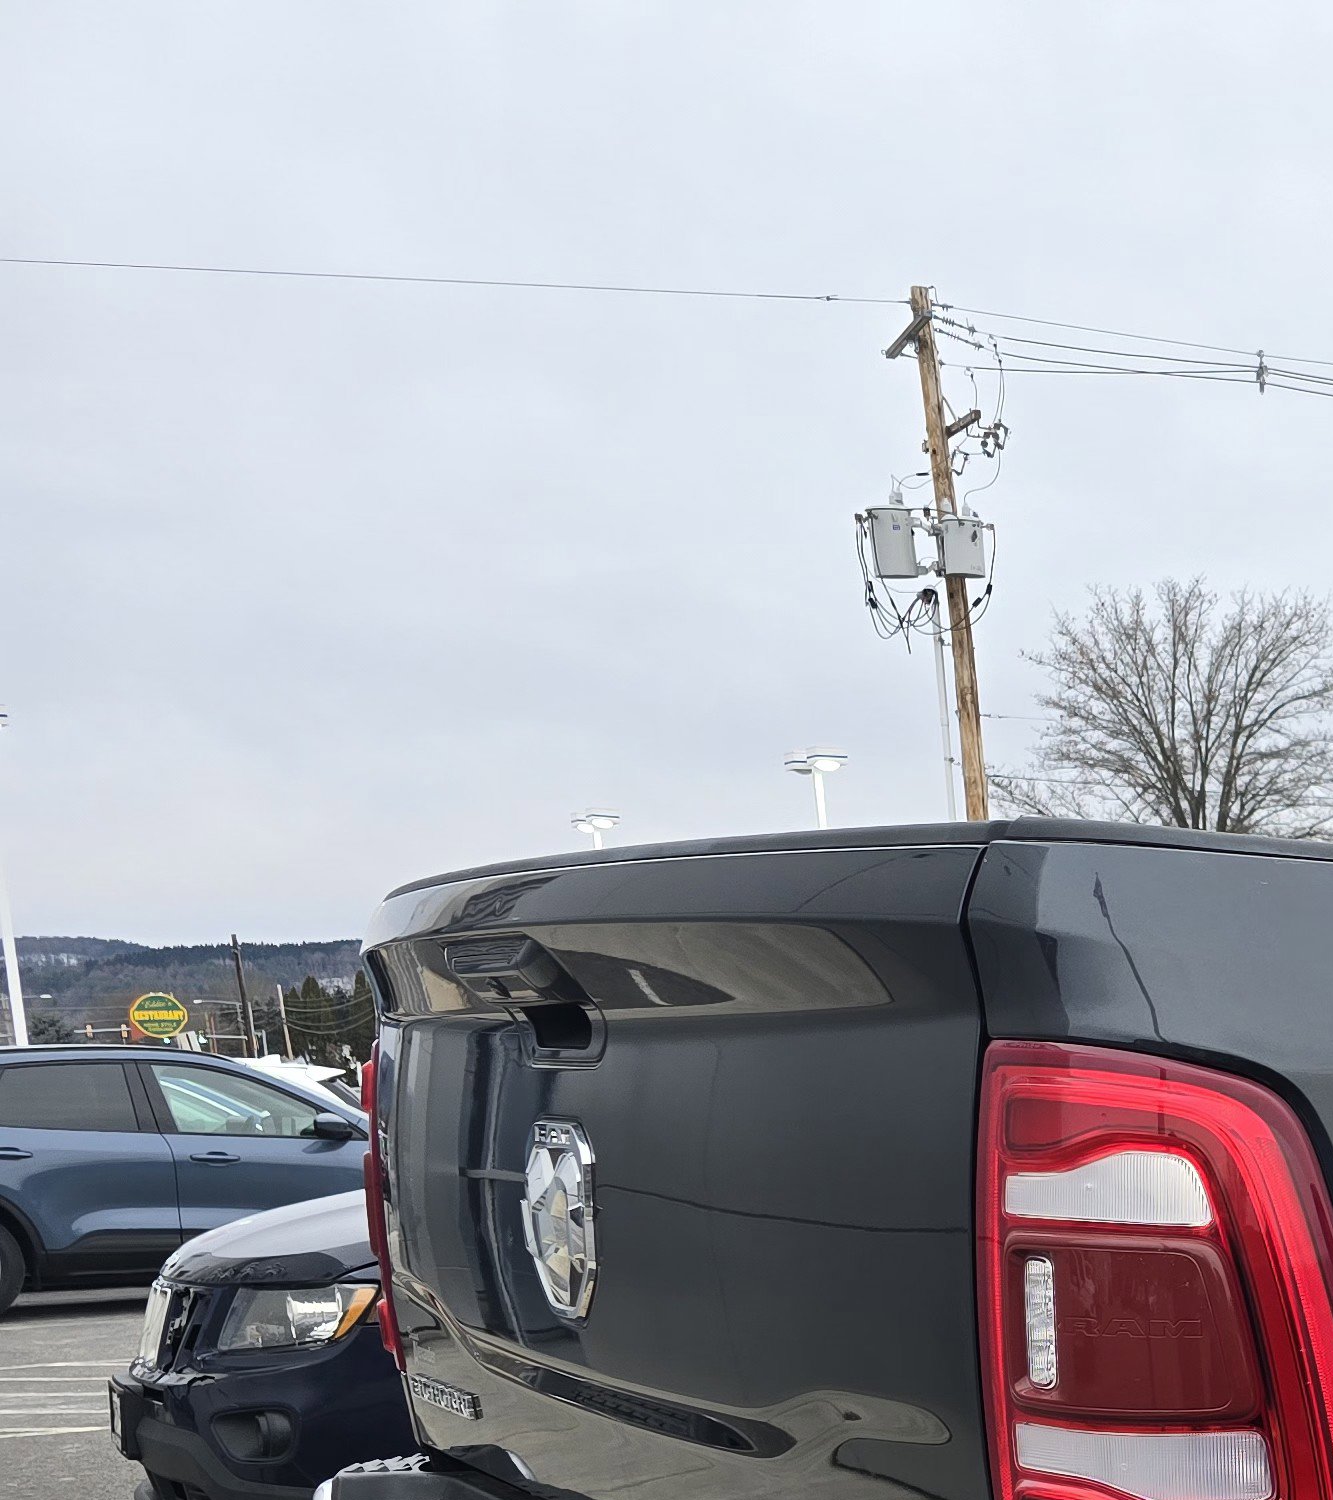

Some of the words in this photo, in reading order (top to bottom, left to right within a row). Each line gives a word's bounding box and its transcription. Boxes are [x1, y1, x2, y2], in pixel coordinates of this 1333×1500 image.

[134, 1010, 184, 1021] RESTAURANT
[534, 1126, 571, 1145] RAM
[1060, 1314, 1204, 1340] RAM
